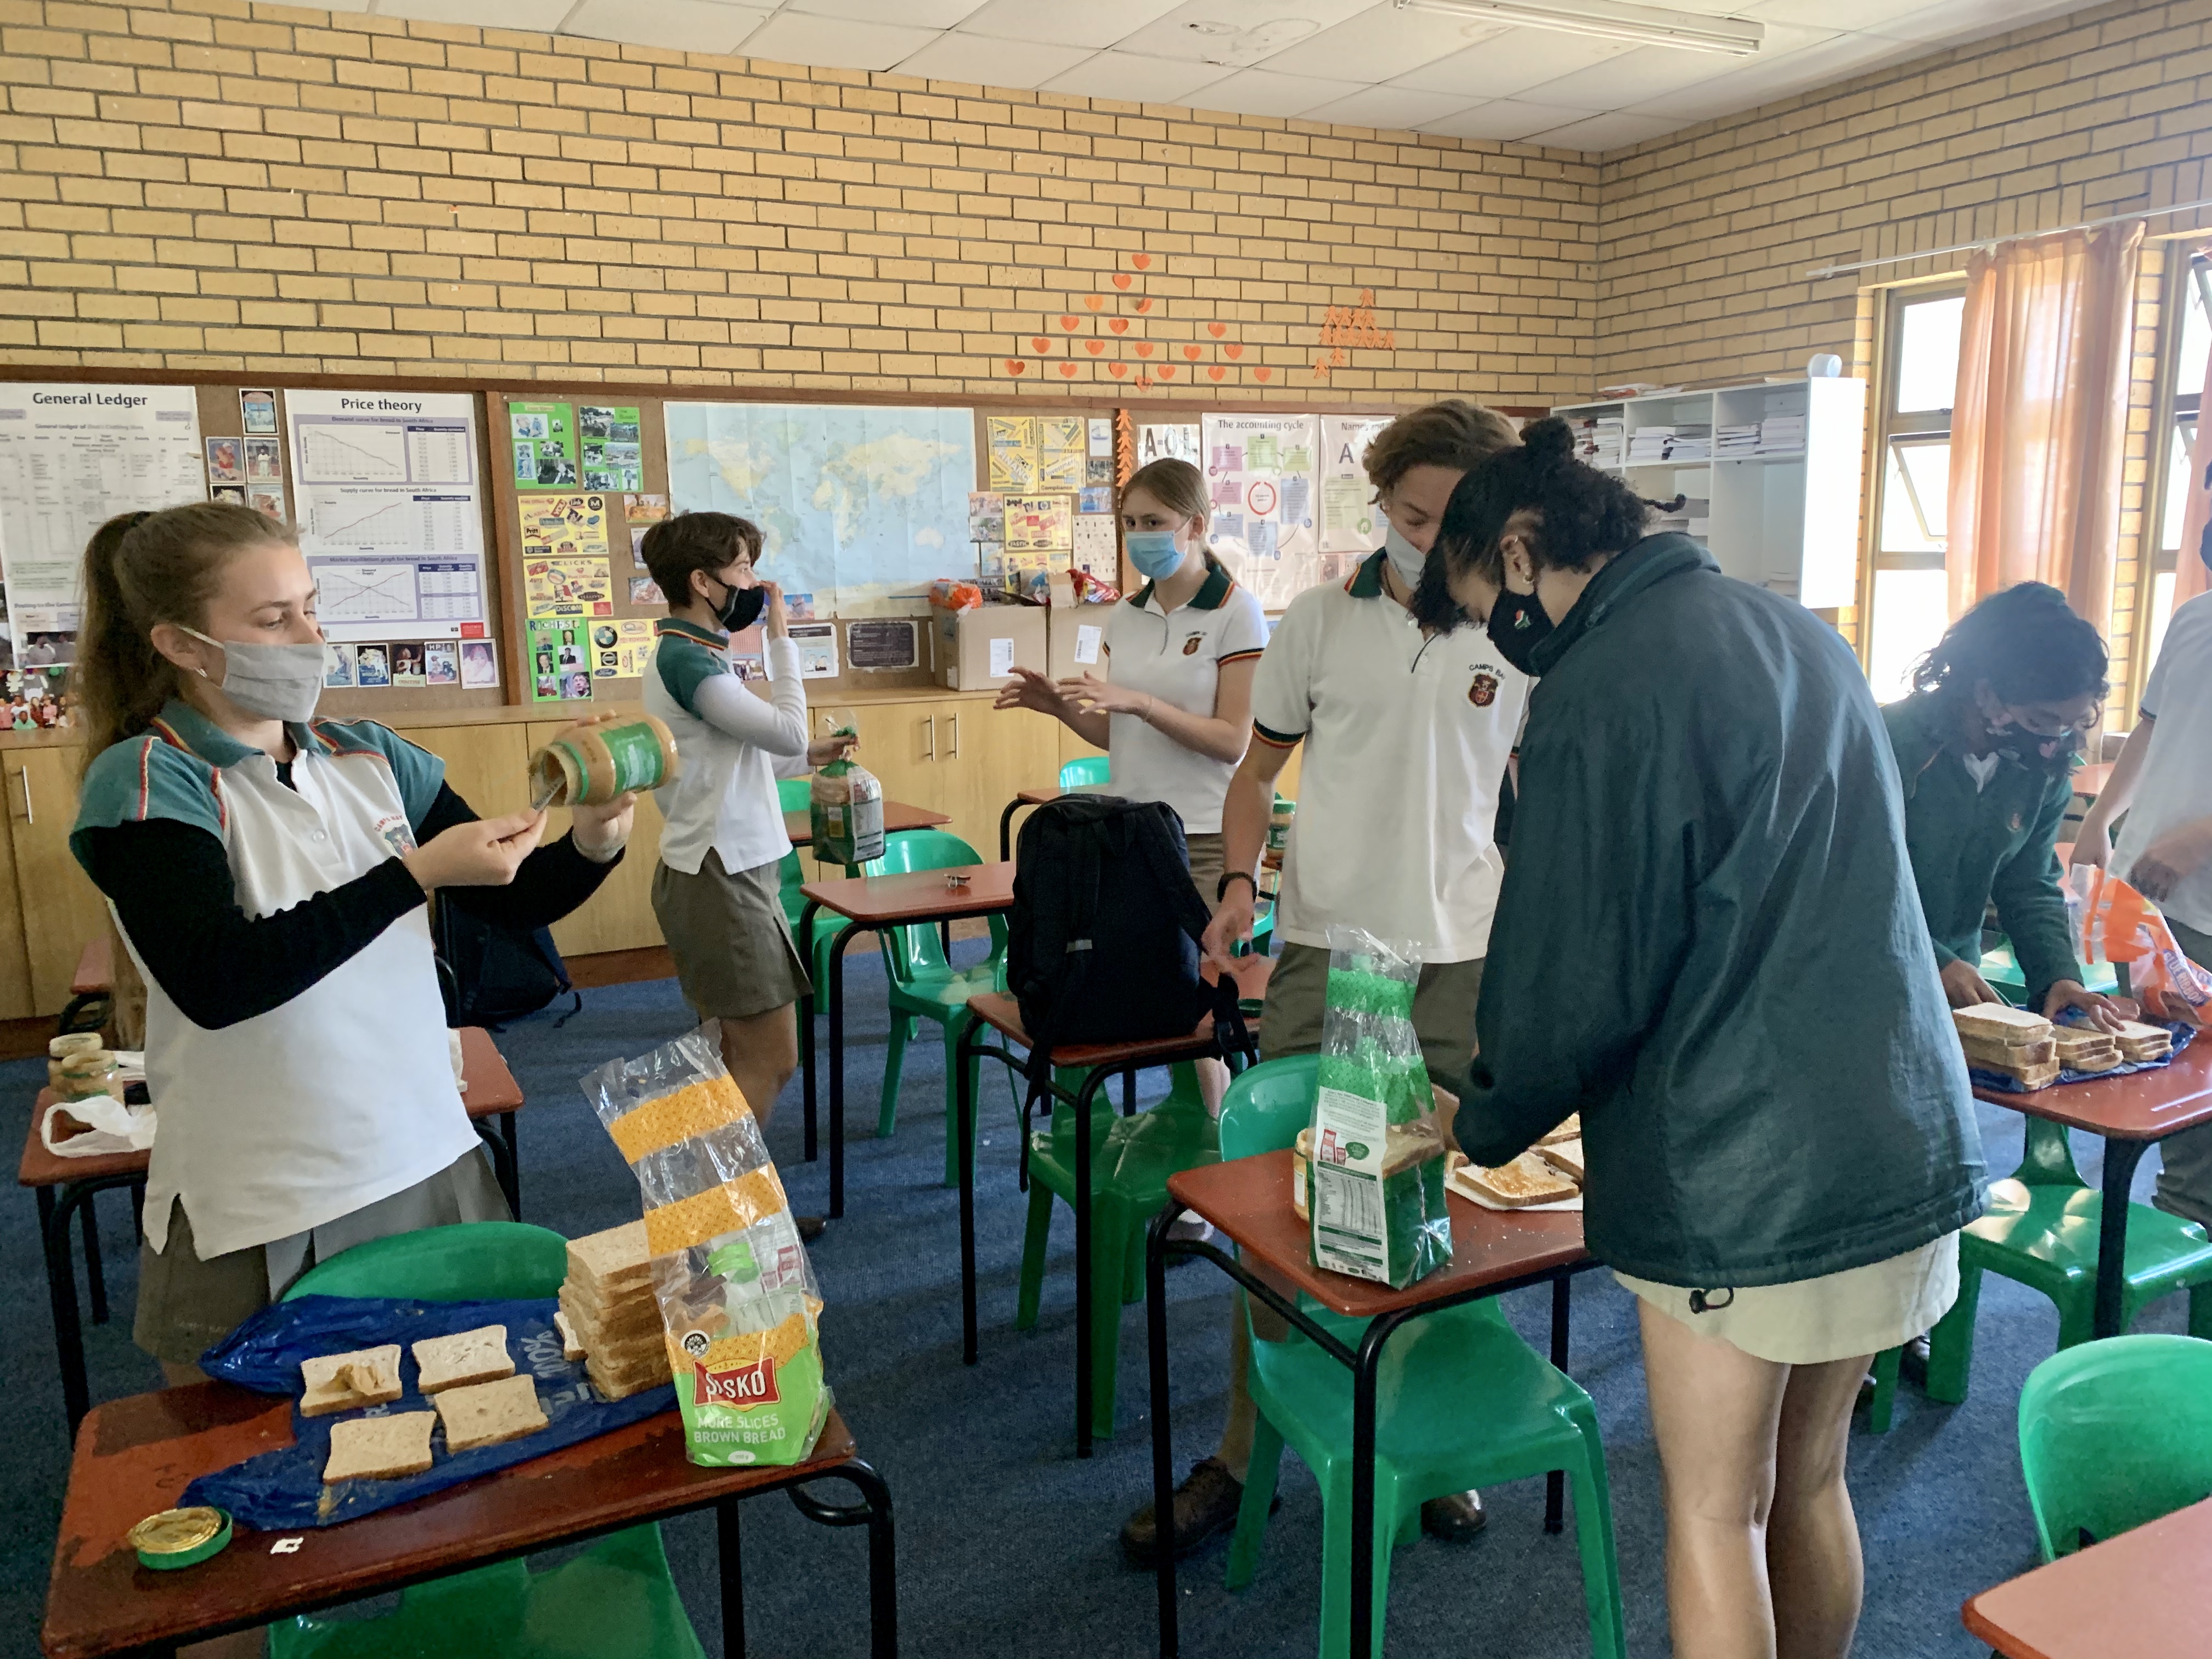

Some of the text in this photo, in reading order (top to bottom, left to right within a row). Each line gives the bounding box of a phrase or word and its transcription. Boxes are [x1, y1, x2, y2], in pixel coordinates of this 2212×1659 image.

[33, 392, 148, 408] General Ledger
[341, 398, 422, 414] Price theory
[1218, 420, 1304, 431] The accounting cycle
[1339, 443, 1355, 464] A
[1469, 663, 1493, 673] CAMPS
[2176, 972, 2205, 1004] RIBBON
[698, 1413, 779, 1429] MORE SLICES
[693, 1427, 786, 1444] BROWN BREAD
